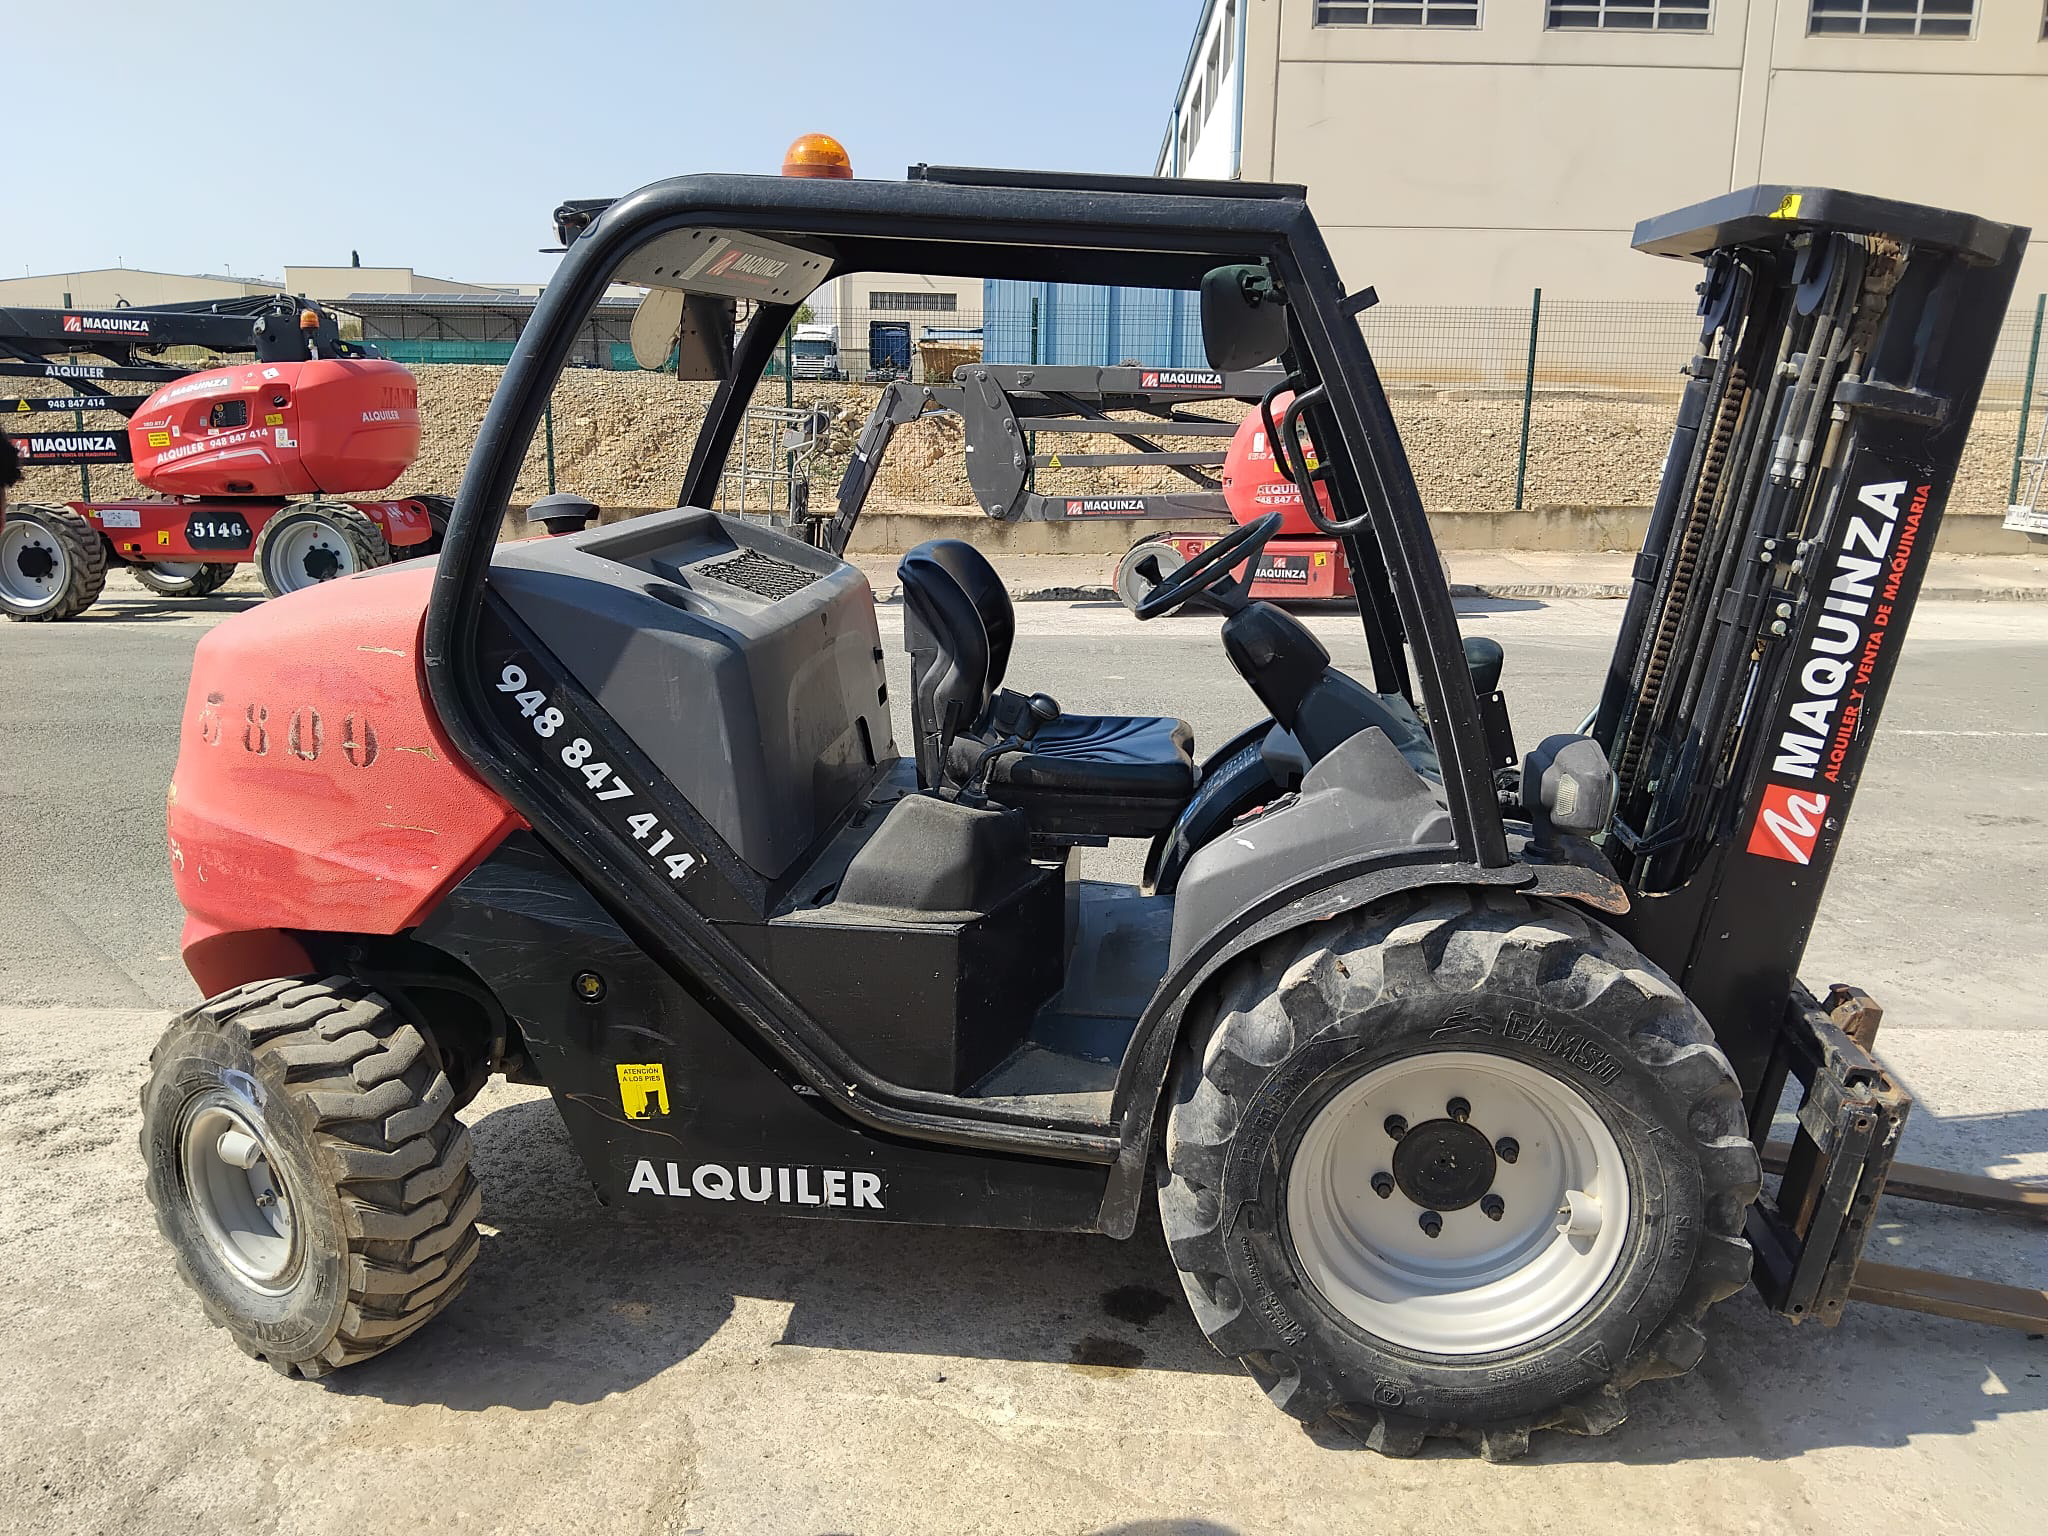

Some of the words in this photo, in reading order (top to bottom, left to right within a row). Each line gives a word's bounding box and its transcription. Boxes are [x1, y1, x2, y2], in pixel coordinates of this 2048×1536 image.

[729, 253, 789, 278] MAQUINZA
[82, 317, 149, 332] MAQUINZA
[45, 366, 104, 378] ALQUILER
[1160, 373, 1222, 385] MAQUINZA
[171, 377, 228, 398] MAQUINZA
[48, 400, 65, 409] 948
[68, 399, 85, 408] 847
[87, 399, 105, 407] 414
[362, 410, 400, 422] ALQUILER
[31, 437, 117, 452] MAQUINZA
[157, 442, 205, 465] ALQUILER
[209, 437, 227, 448] 948
[229, 433, 246, 445] 847
[249, 428, 268, 439] 414
[1257, 484, 1301, 495] ALQUIL
[1084, 500, 1145, 511] MAQUINZA
[193, 522, 242, 538] 5146
[1882, 484, 1932, 602] MAQUINARIA
[1874, 603, 1893, 628] DE
[1773, 481, 1908, 779] MAQUINZA
[1855, 632, 1883, 685] VENTA
[1850, 687, 1866, 702] Y
[1825, 708, 1858, 783] ALQUILER
[496, 664, 565, 738] 948
[561, 737, 635, 801] 847
[626, 812, 696, 880] 414
[1503, 1010, 1624, 1085] CAMSO
[623, 1067, 659, 1075] ATENCIÓN
[628, 1159, 885, 1209] ALQUILER
